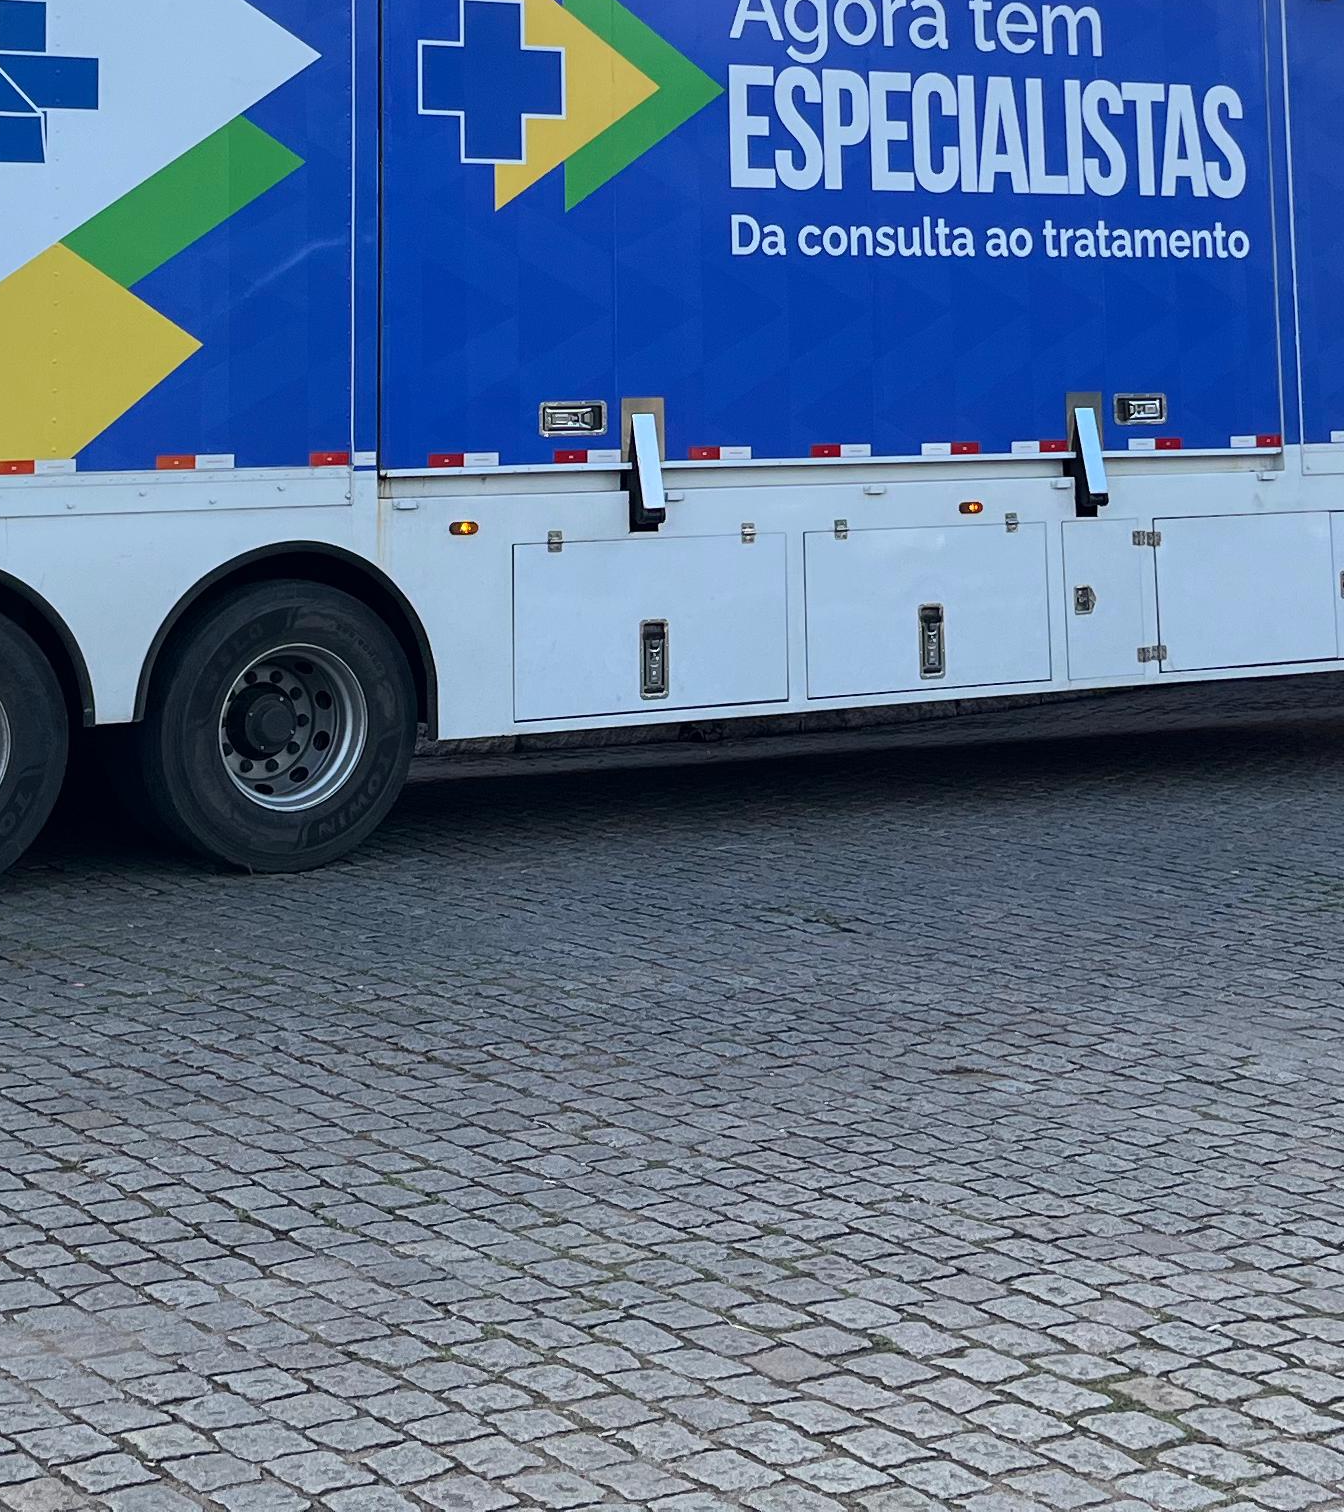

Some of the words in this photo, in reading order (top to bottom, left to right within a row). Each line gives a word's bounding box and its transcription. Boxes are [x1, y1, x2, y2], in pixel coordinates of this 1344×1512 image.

[728, 64, 1247, 199] ESPECIALISTAS
[730, 214, 787, 256] Da
[797, 215, 976, 257] consulta
[985, 227, 1033, 258] ao
[1042, 219, 1250, 259] tratamento
